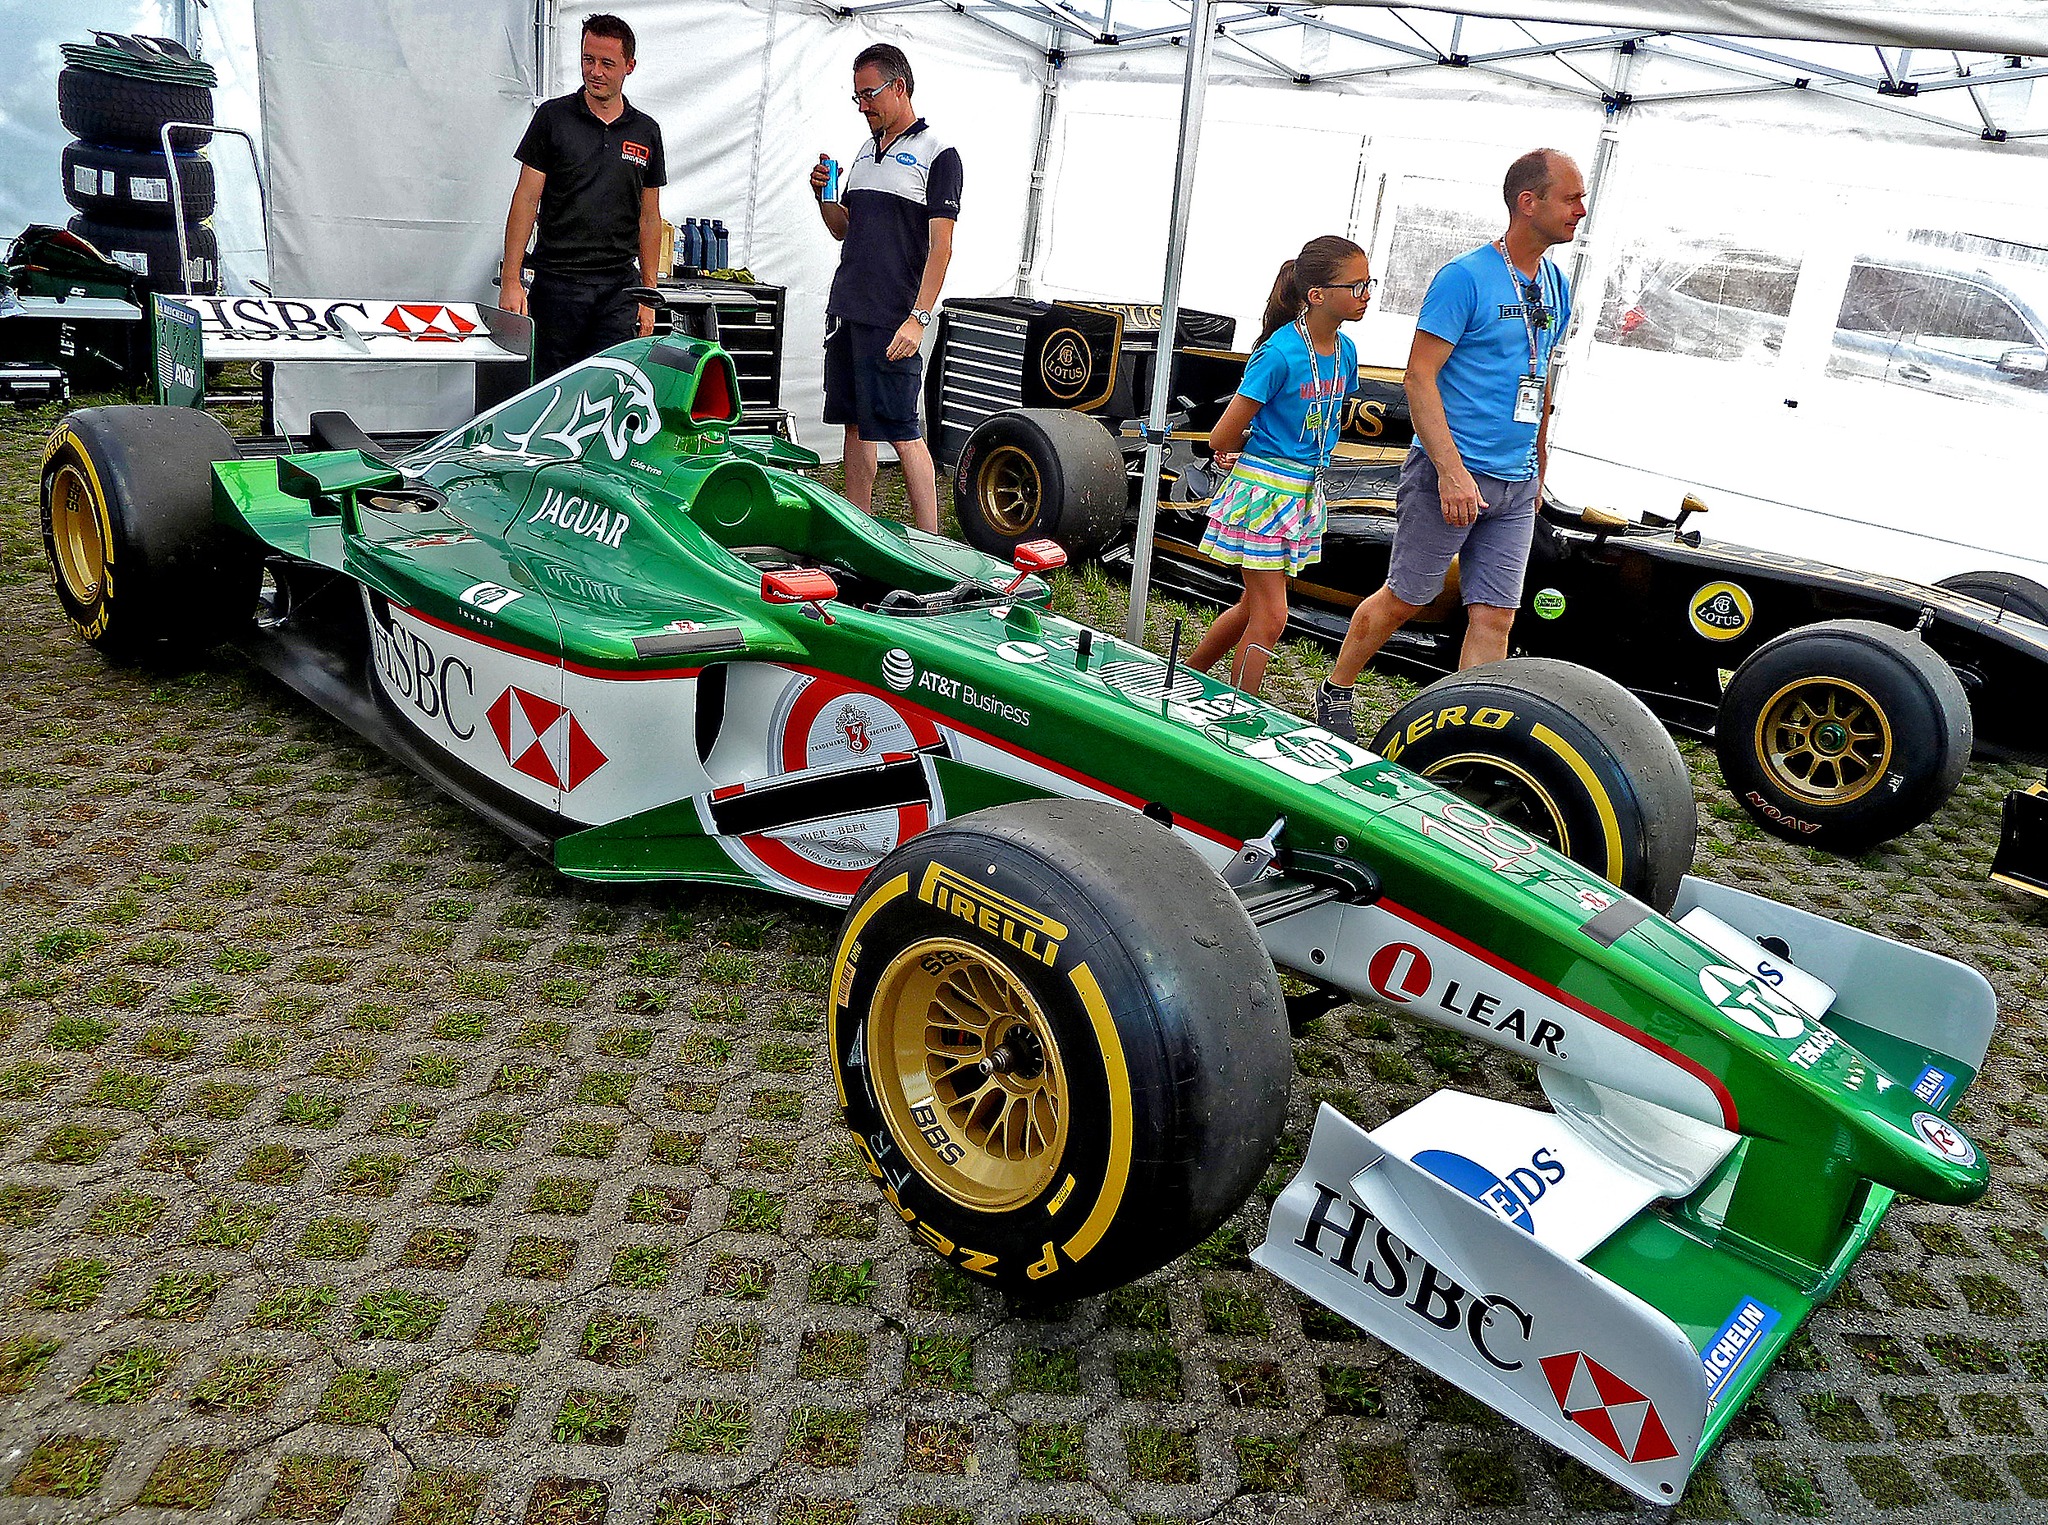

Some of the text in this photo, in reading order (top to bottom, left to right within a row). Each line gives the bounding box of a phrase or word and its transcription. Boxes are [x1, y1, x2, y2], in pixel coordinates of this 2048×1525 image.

[163, 303, 195, 324] MICHELIN
[172, 299, 370, 340] HSBC
[174, 361, 196, 389] AT&T
[1047, 360, 1083, 380] LOTUS
[631, 458, 646, 470] Eddie
[958, 443, 977, 496] AVON
[527, 487, 631, 550] JAGUAR
[458, 606, 494, 629] invent
[1697, 606, 1741, 626] LOTUS
[375, 617, 477, 743] HSBC
[918, 671, 1031, 727] AT&T Business
[1381, 706, 1515, 764] ZERO
[800, 823, 868, 841] BIER BEER
[1745, 790, 1823, 834] AVON
[918, 860, 1069, 968] PIRELLI
[1439, 979, 1567, 1058] LEAR
[910, 1104, 966, 1167] BBS
[1479, 1147, 1567, 1223] EDS
[1294, 1182, 1535, 1372] HSBC
